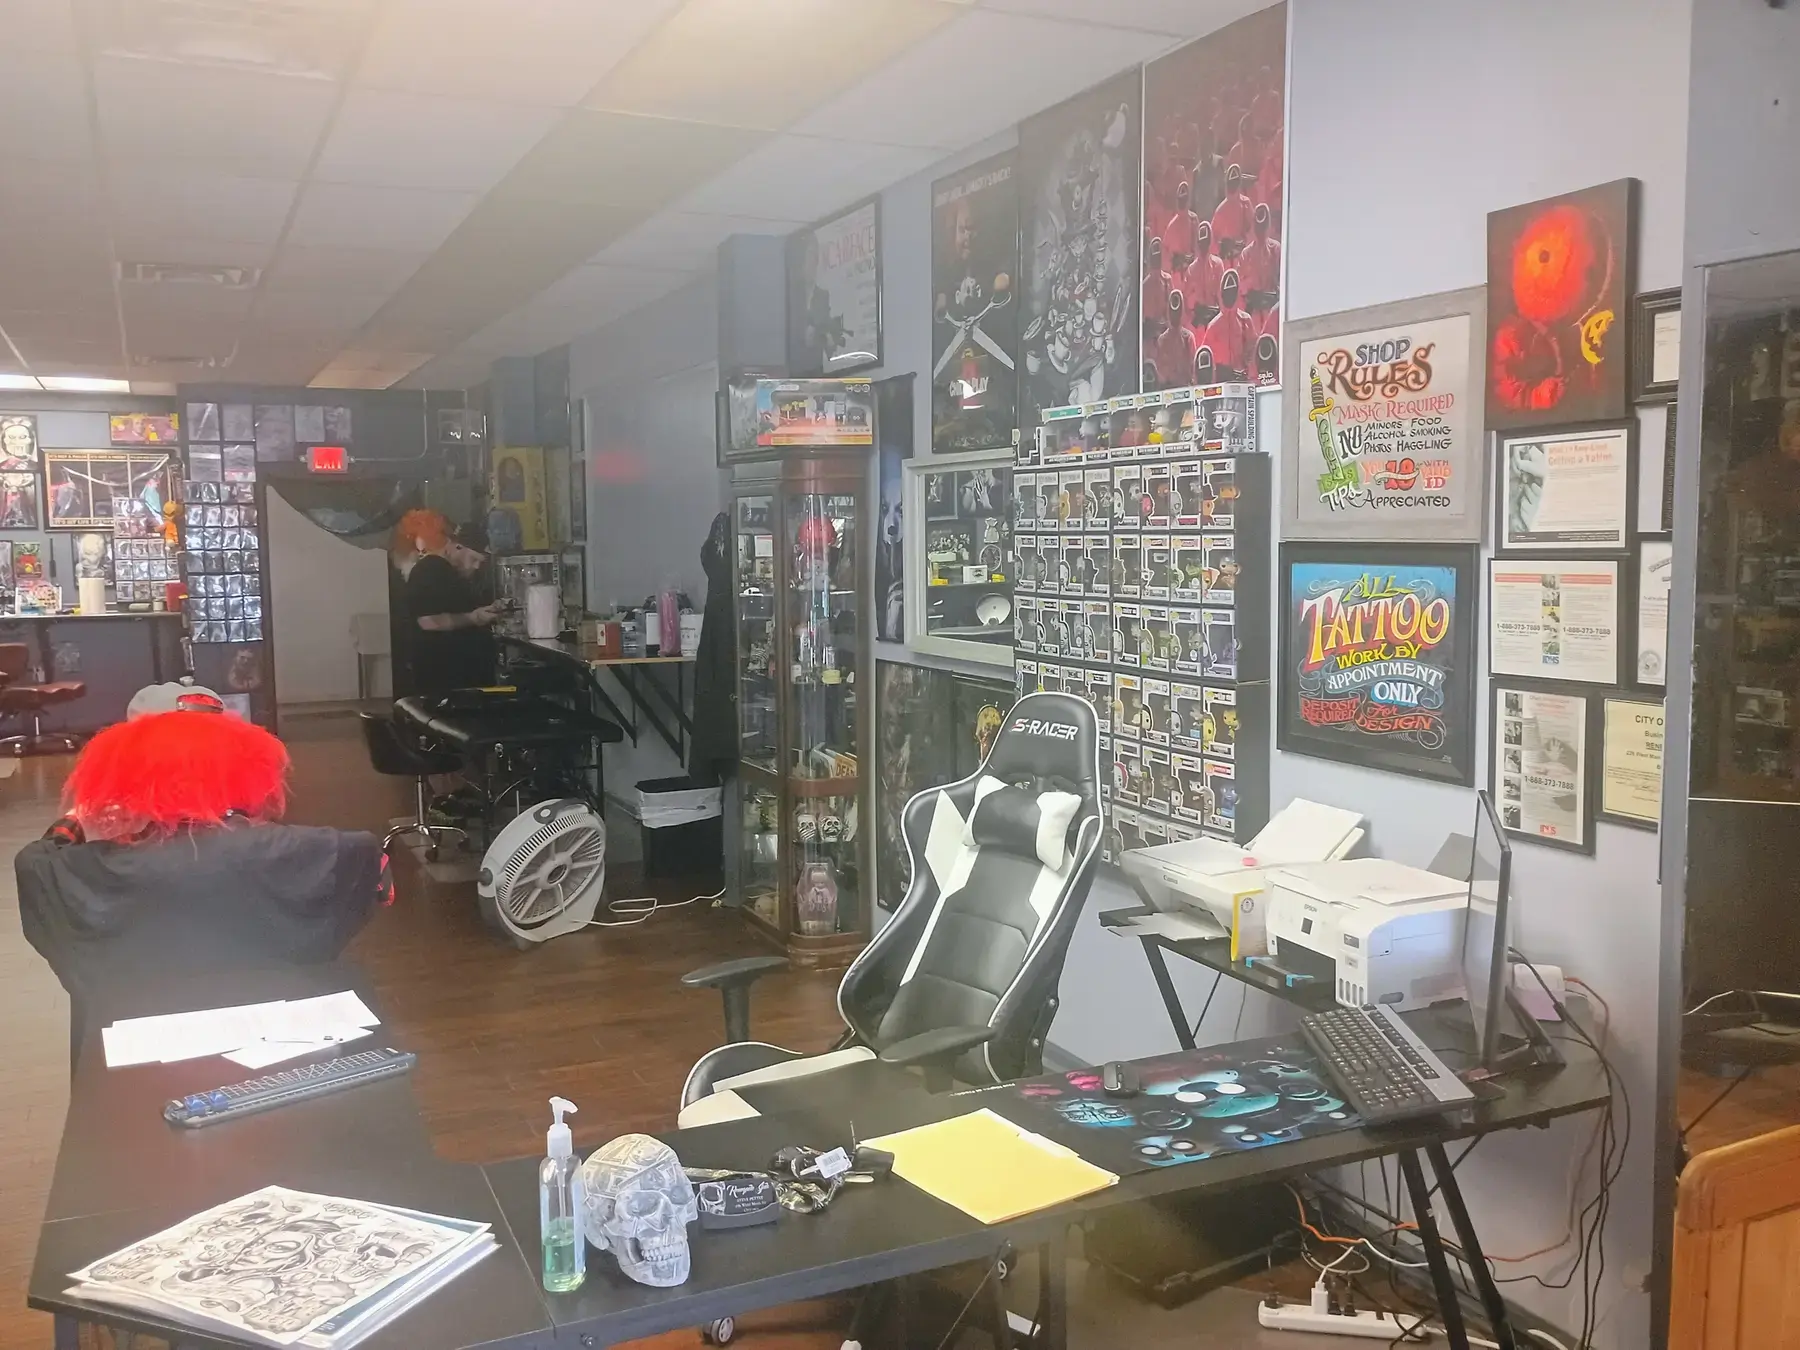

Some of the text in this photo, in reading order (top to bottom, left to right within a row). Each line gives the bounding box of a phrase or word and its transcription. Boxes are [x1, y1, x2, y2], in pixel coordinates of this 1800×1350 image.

[1354, 338, 1411, 366] SHOP
[1317, 342, 1435, 400] RULES
[1247, 386, 1255, 440] CAPTAIN SPAULDING
[1333, 393, 1455, 425] MASK REQUIRED
[1364, 417, 1442, 433] MINORS FOOD
[1364, 426, 1452, 441] ALCOHOL SMOKING
[1338, 425, 1362, 460] NO
[1364, 439, 1452, 454] PHOTOS HAGGLING
[1422, 476, 1446, 490] ID
[1364, 489, 1451, 509] APPRECIATED
[1343, 573, 1416, 602] ALL
[1301, 588, 1449, 666] TATTOO
[1336, 640, 1422, 670] WORK BY
[1328, 663, 1442, 690] APPOINTMENT
[1301, 698, 1358, 711] DEPOSIT
[1372, 682, 1423, 705] ONLY
[1301, 709, 1357, 726] REQUIRED
[1356, 714, 1432, 731] DESIGN
[1635, 714, 1654, 725] CITY
[1011, 718, 1079, 741] S-RACER
